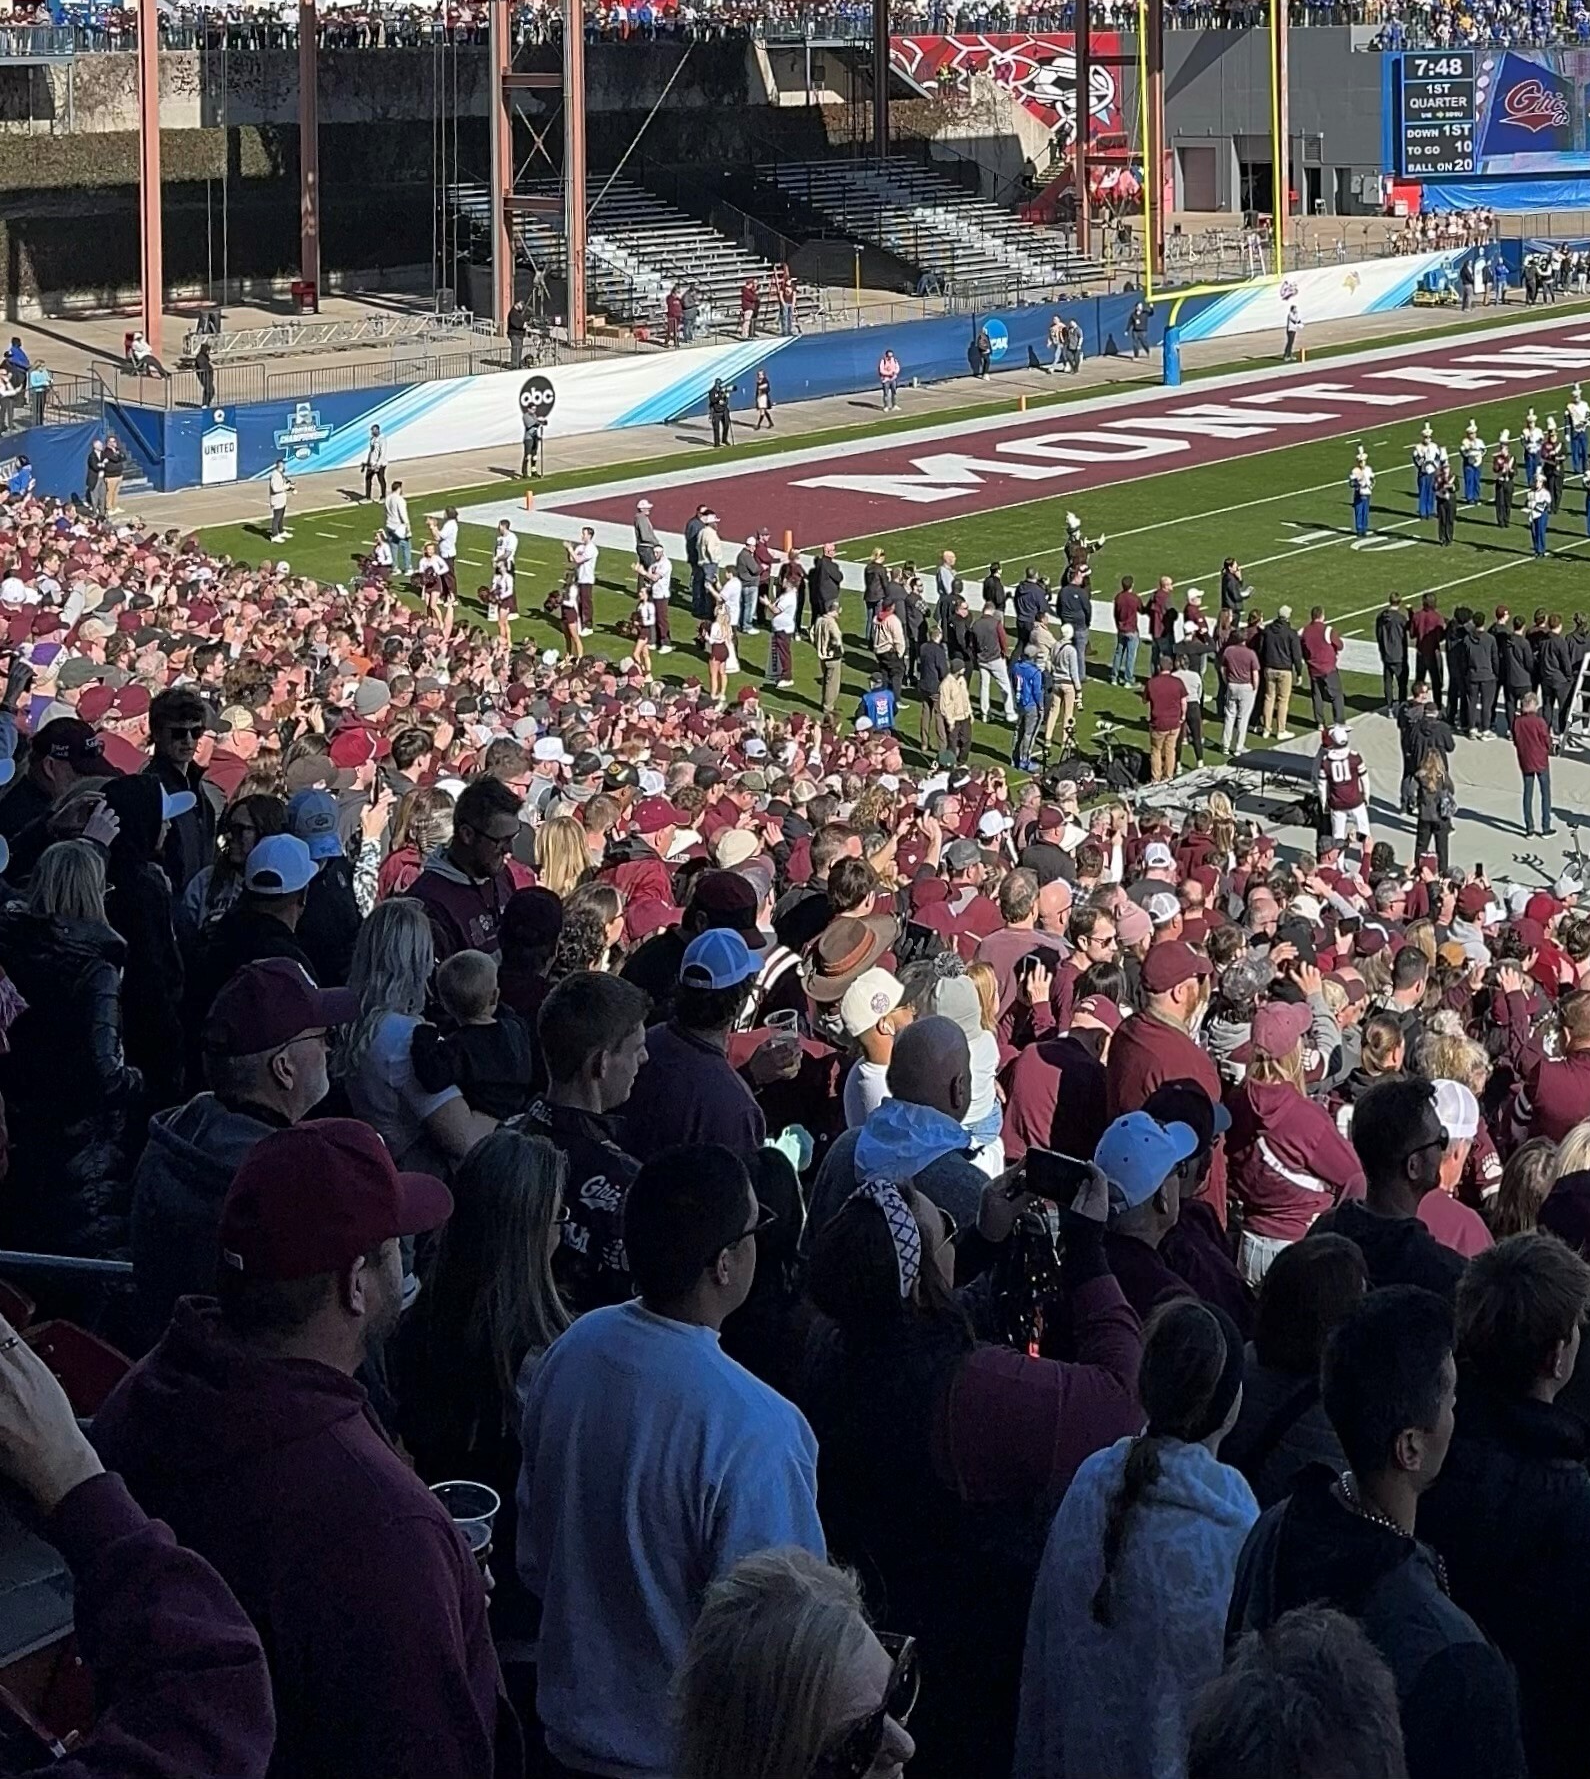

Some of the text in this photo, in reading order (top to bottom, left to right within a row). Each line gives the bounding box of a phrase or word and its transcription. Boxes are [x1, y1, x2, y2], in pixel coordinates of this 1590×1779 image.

[1415, 59, 1462, 76] 7:48
[1426, 84, 1450, 94] 1ST
[1410, 97, 1467, 108] QUARTER
[1407, 125, 1471, 138] DOWN 1ST
[1407, 141, 1472, 155] TO GO 10
[1408, 159, 1472, 172] BALL ON 20
[521, 387, 554, 406] abc
[205, 443, 234, 455] UNITED
[1332, 760, 1351, 783] 01
[580, 1175, 621, 1203] Griz
